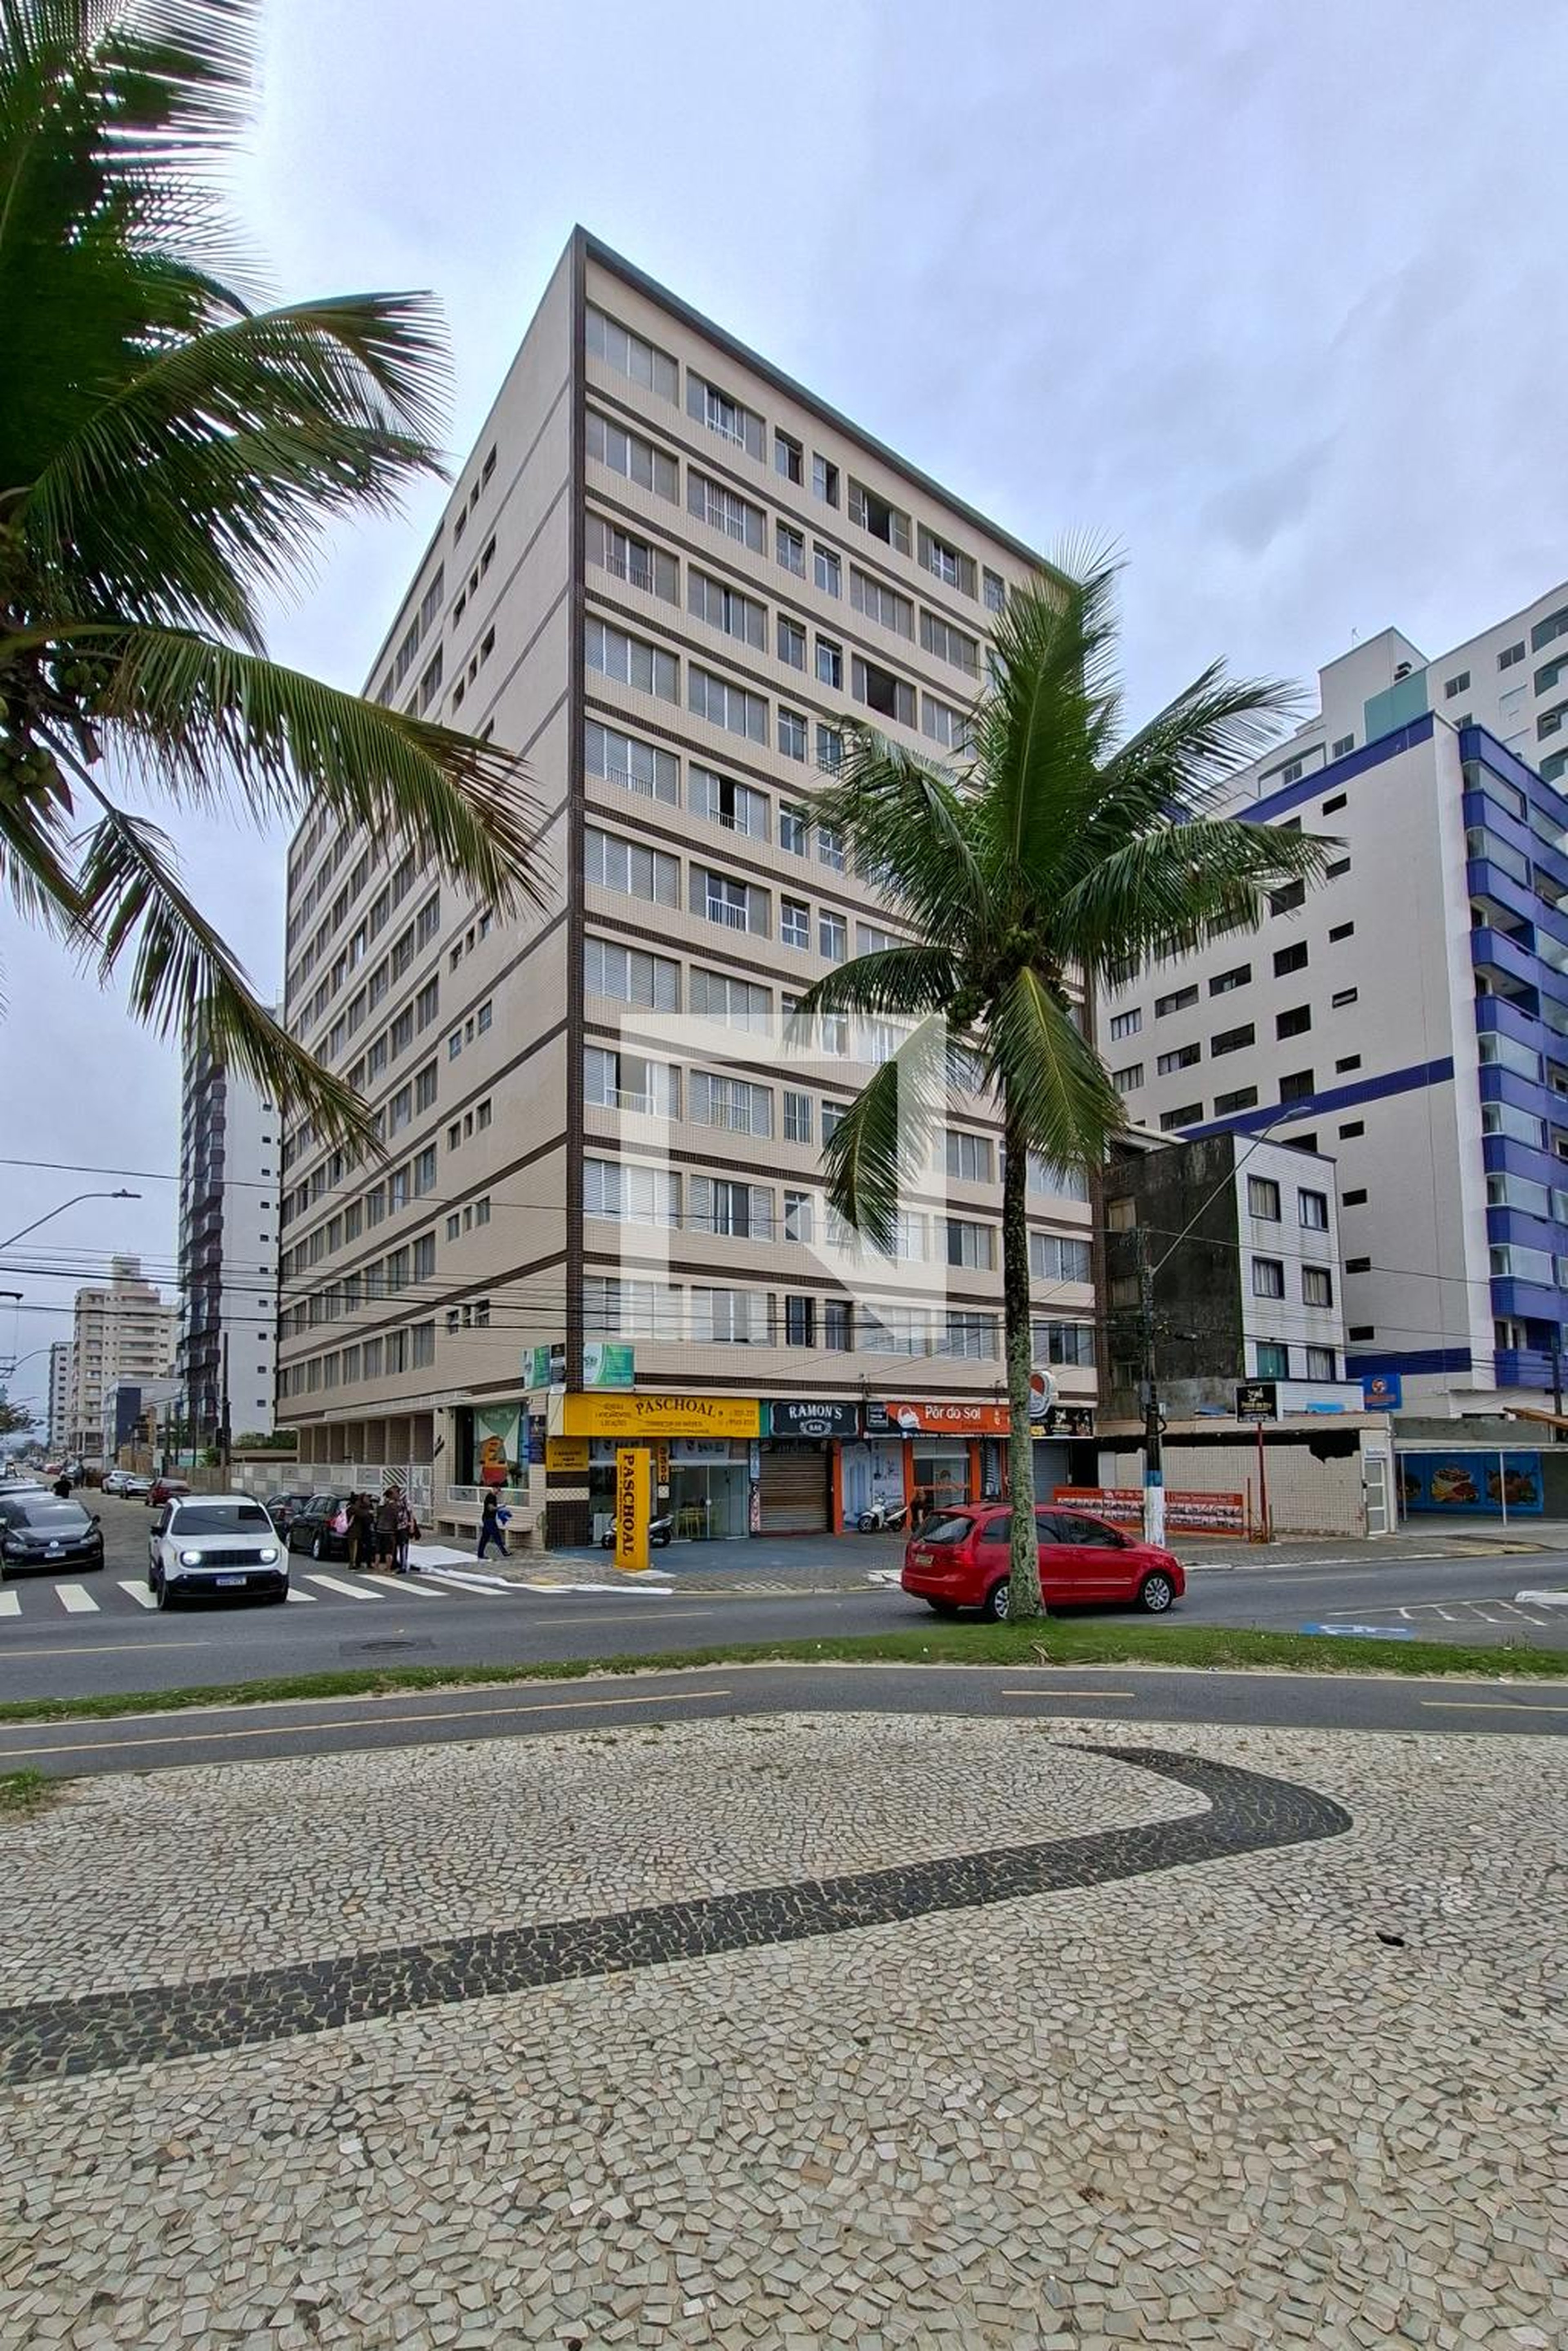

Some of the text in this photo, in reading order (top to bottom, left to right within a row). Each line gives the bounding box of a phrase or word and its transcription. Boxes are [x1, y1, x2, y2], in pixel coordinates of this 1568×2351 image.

[636, 1398, 715, 1418] PASCHOAL
[789, 1404, 842, 1420] RAMON'S
[946, 1407, 960, 1419] do
[963, 1407, 981, 1419] Sol
[623, 1454, 635, 1557] PASCHOAL
